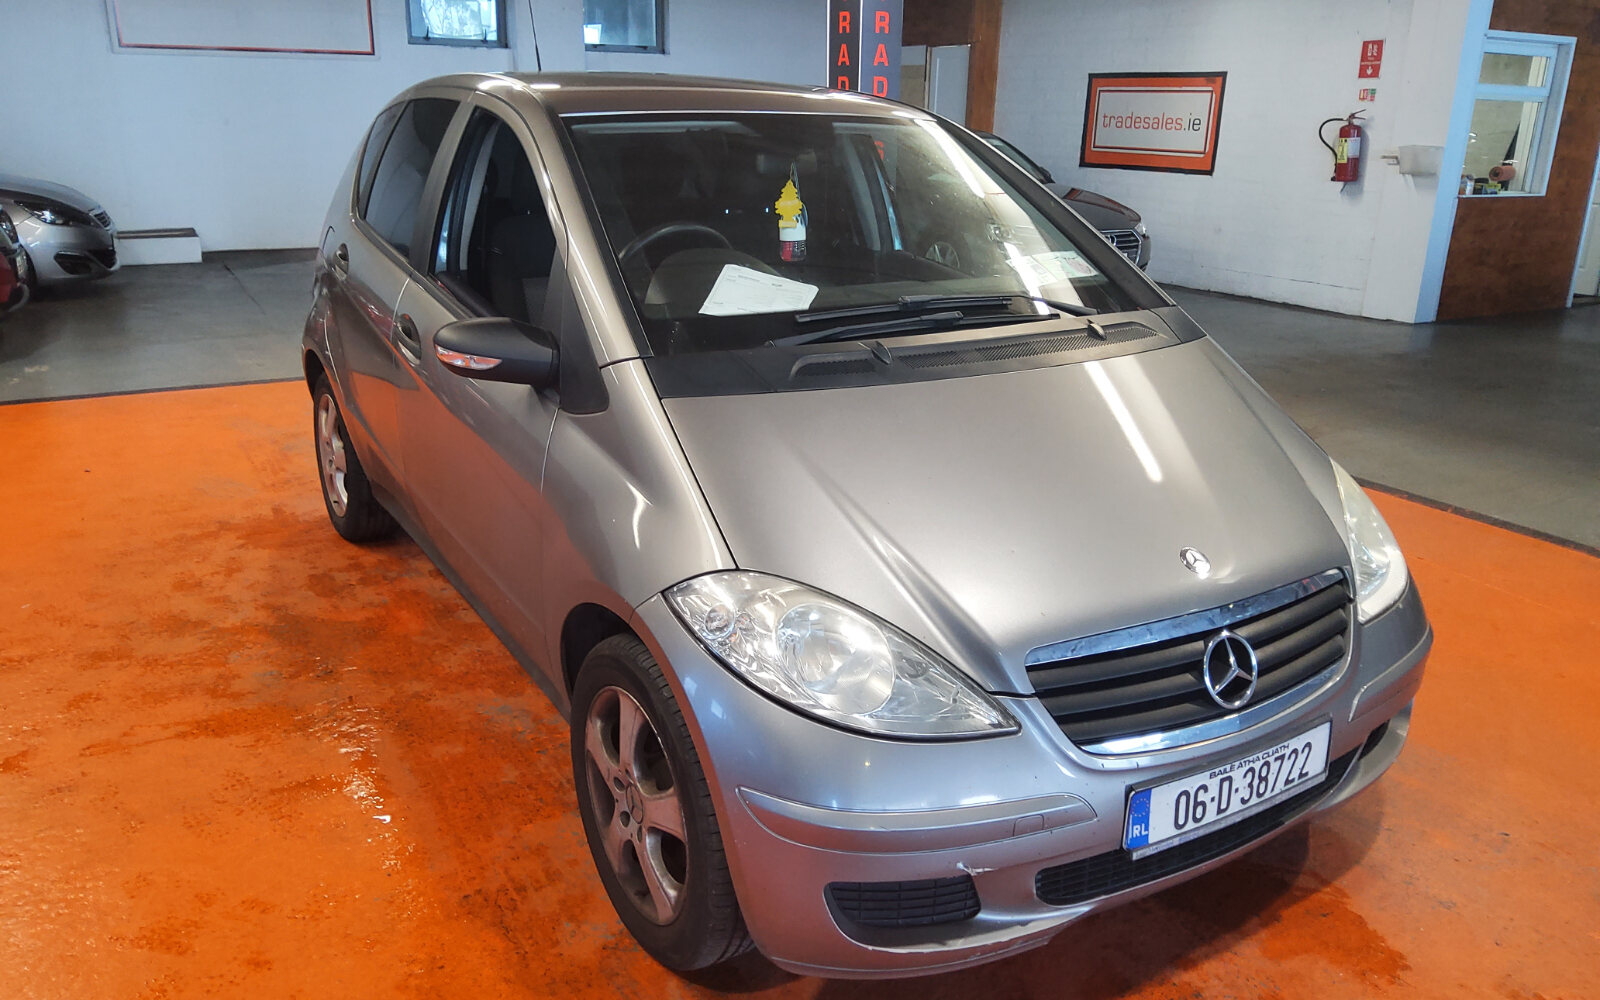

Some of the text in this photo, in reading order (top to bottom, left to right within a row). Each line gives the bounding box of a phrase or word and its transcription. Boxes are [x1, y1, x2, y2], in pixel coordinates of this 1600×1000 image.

[837, 0, 851, 90] RAD
[873, 0, 890, 97] RAD
[1102, 112, 1202, 132] tradesales.ie
[1173, 741, 1313, 830] 06-D-38722
